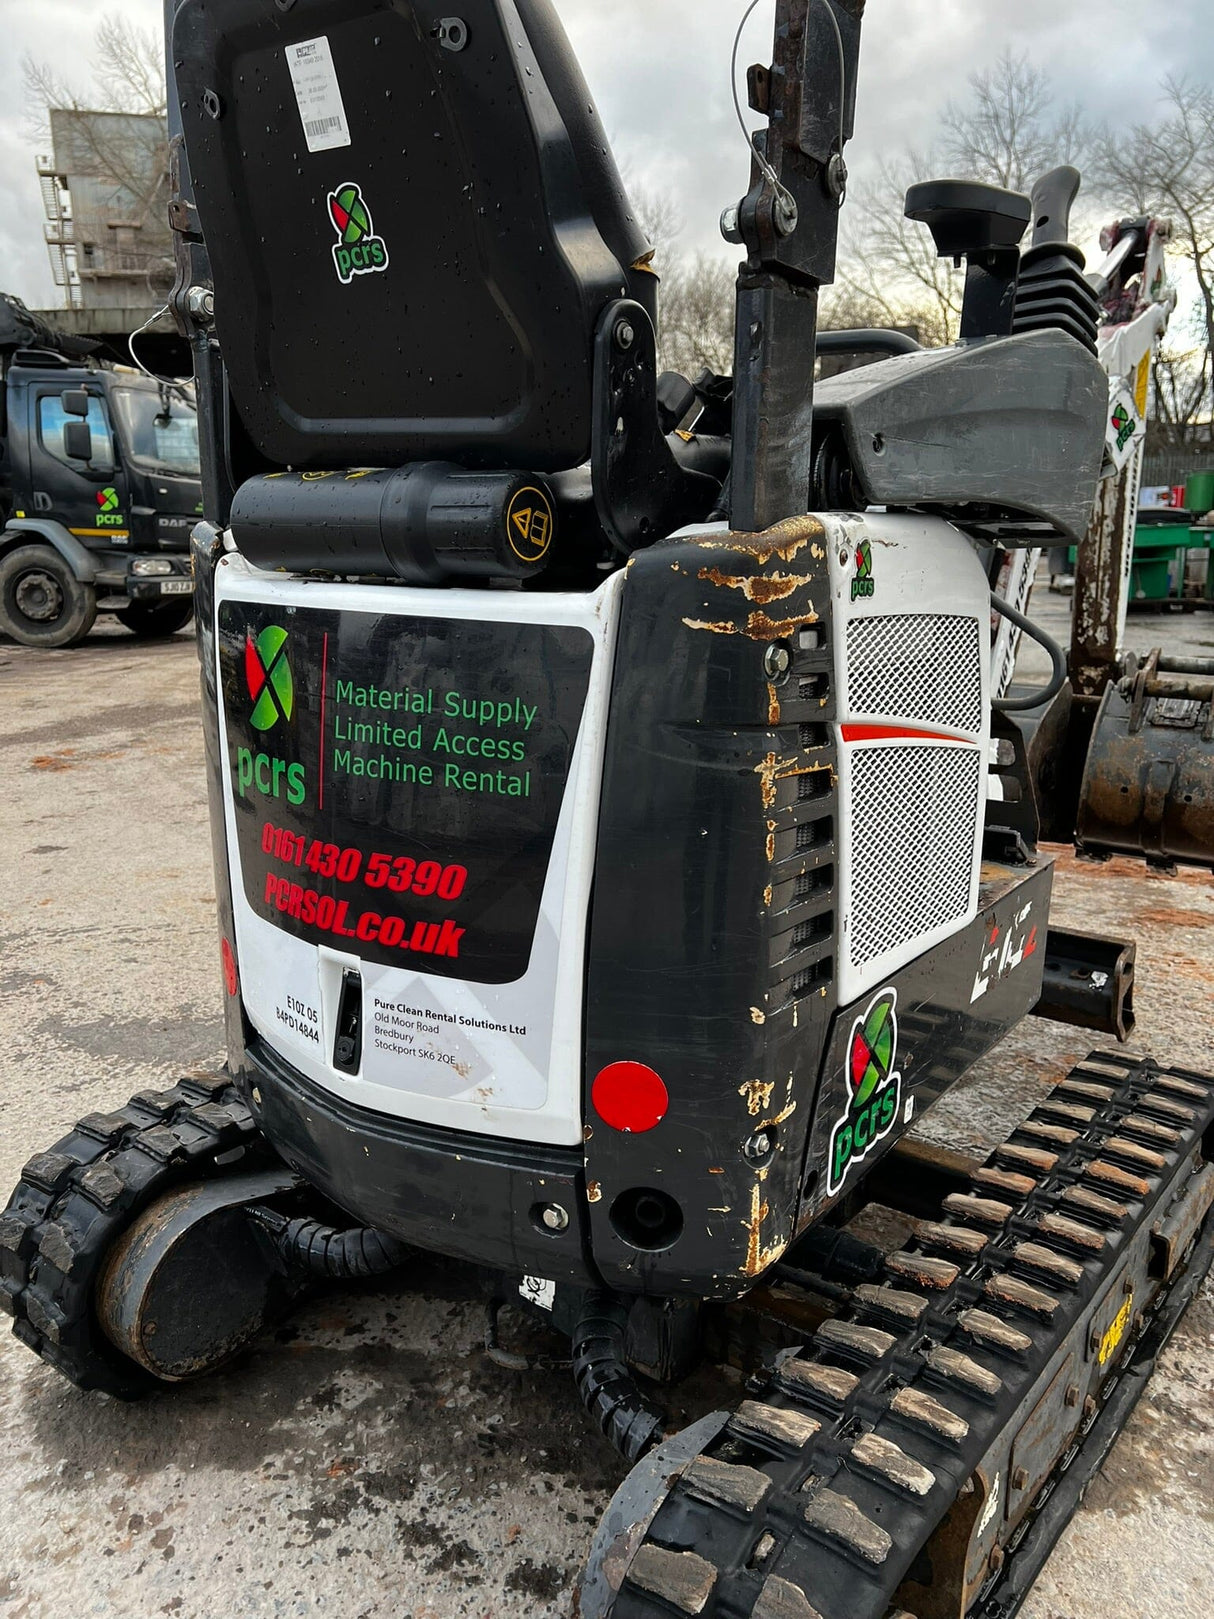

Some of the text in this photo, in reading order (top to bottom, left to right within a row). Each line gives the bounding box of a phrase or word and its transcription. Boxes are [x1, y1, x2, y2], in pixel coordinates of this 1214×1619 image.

[337, 243, 384, 276] pcrs
[95, 514, 123, 527] pcrs
[159, 518, 187, 528] DAF
[852, 580, 874, 600] pcrs
[336, 680, 538, 731] Material Supply
[335, 715, 525, 761] Limited Access
[237, 746, 306, 805] pcrs
[334, 749, 530, 797] Machine Rental
[261, 822, 468, 900] 0161 430 5390
[265, 872, 466, 958] PCRSOL.co.uk
[374, 998, 526, 1035] Pure Clean Rental Solutions Ltd
[374, 1012, 439, 1034] Old Moor Road
[374, 1025, 414, 1044] Bredbury
[374, 1038, 456, 1065] Stockport SK6 2QE
[834, 1087, 895, 1181] pcrs
